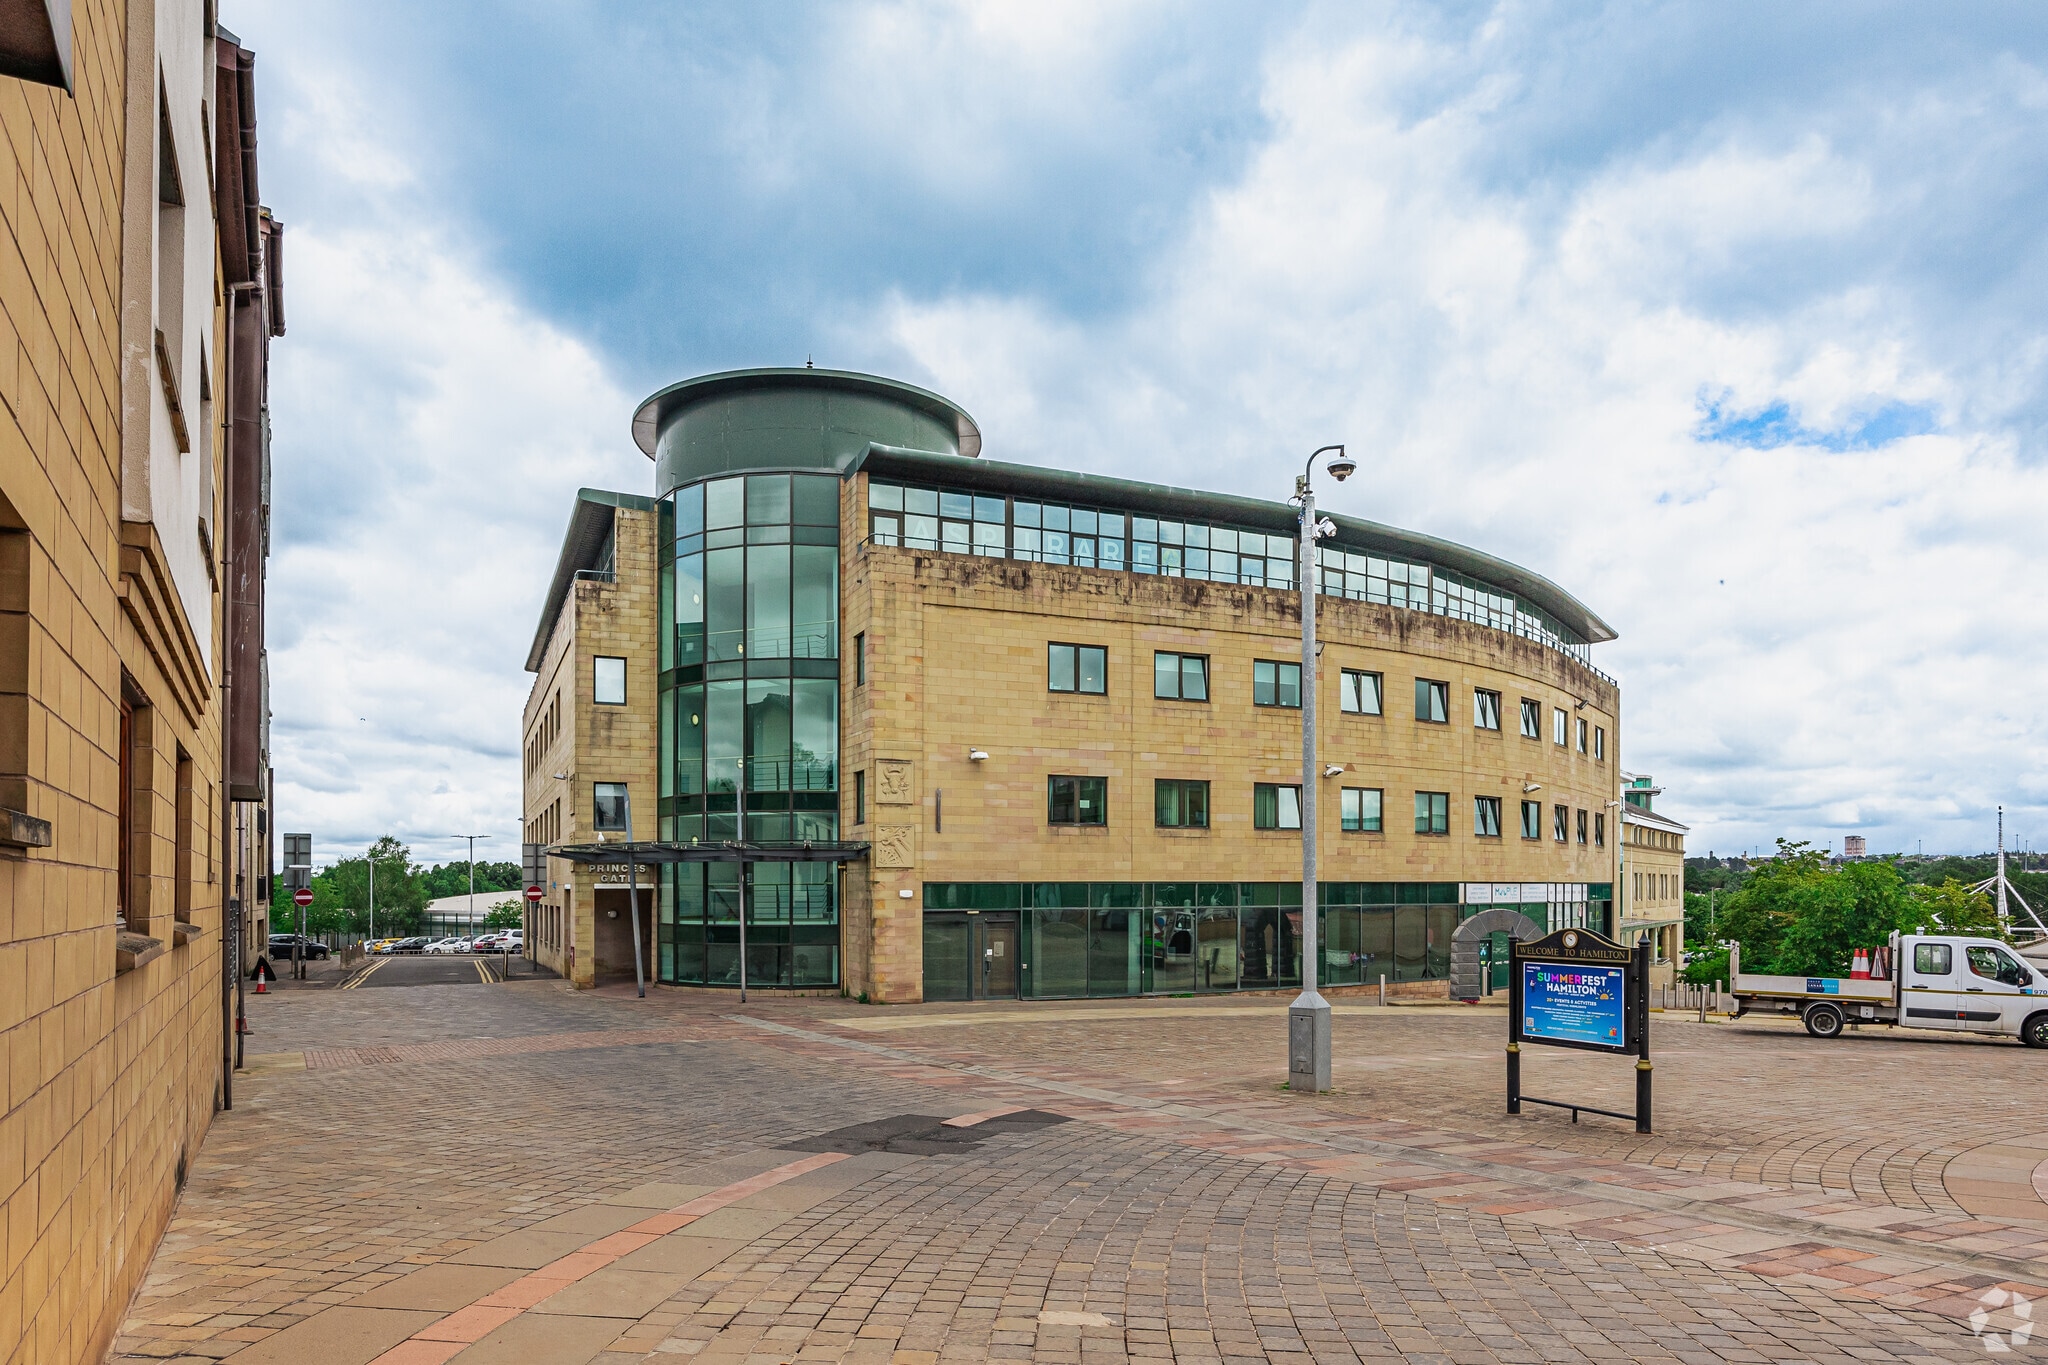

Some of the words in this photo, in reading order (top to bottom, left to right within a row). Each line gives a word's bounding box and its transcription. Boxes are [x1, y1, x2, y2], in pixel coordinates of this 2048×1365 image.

[1519, 946, 1559, 956] WELCOME
[1564, 948, 1576, 957] TO
[1580, 948, 1626, 959] HAMILTON
[1537, 972, 1607, 987] SUMMERFEST
[1546, 982, 1597, 995] HAMILTON
